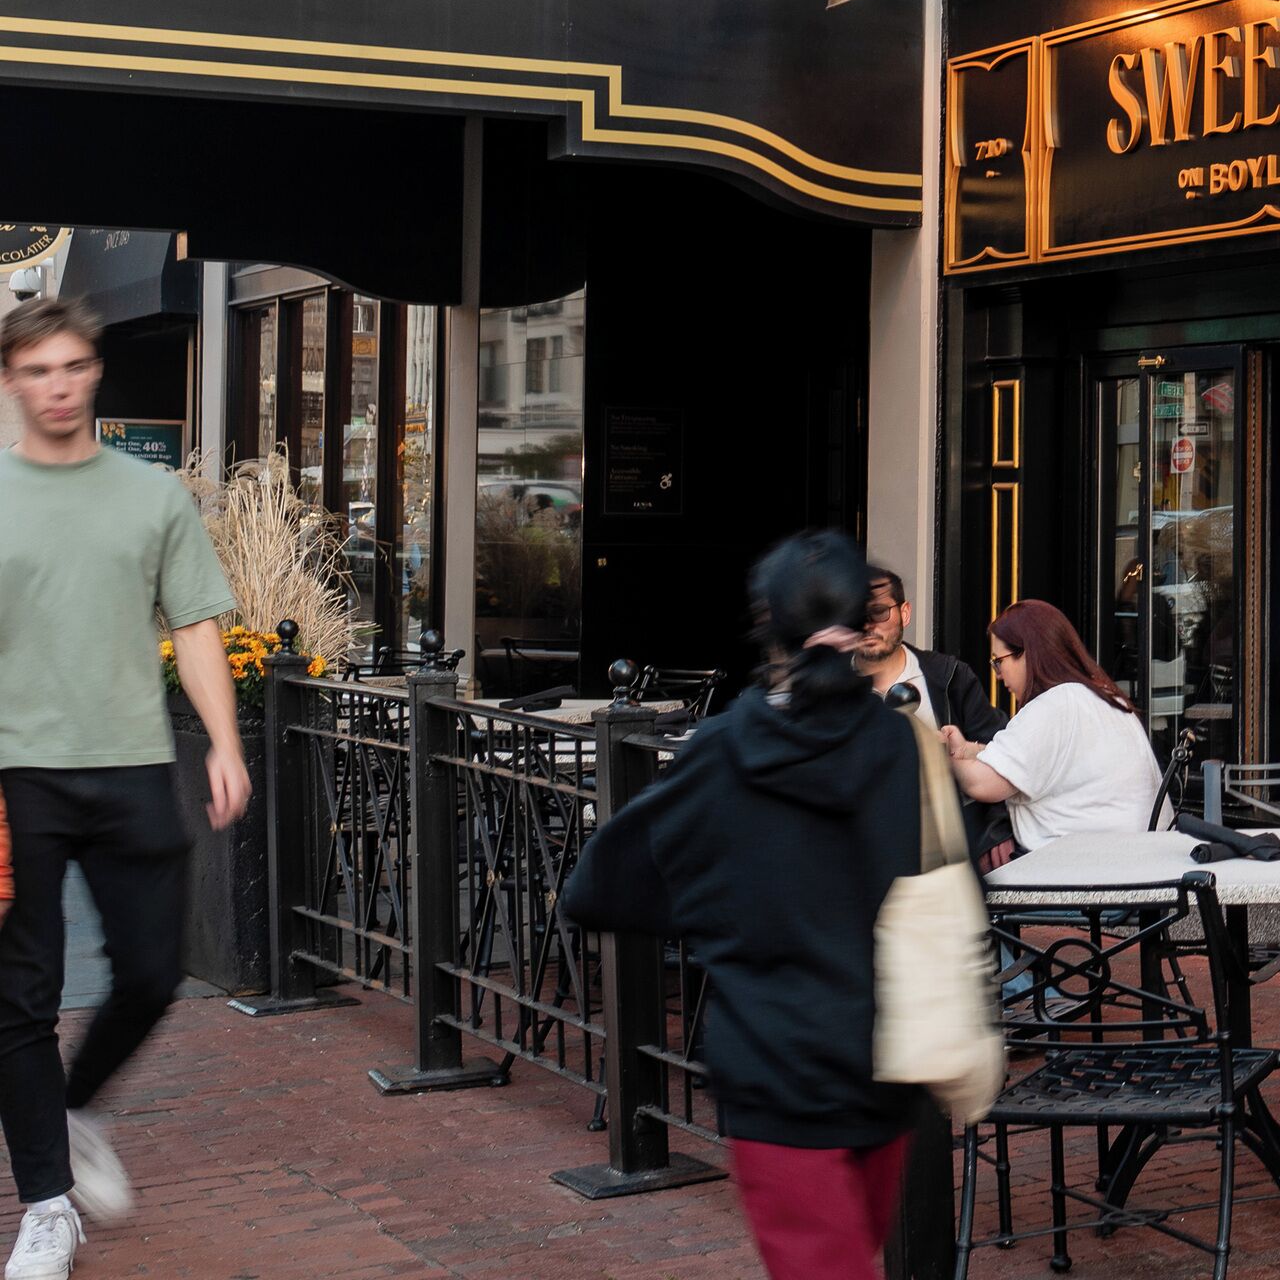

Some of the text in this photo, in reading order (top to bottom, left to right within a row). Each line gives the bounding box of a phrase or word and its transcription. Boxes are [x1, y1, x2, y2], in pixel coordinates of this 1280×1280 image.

[975, 137, 1008, 161] 710
[1178, 166, 1204, 200] ON
[0, 234, 53, 262] COLATIER
